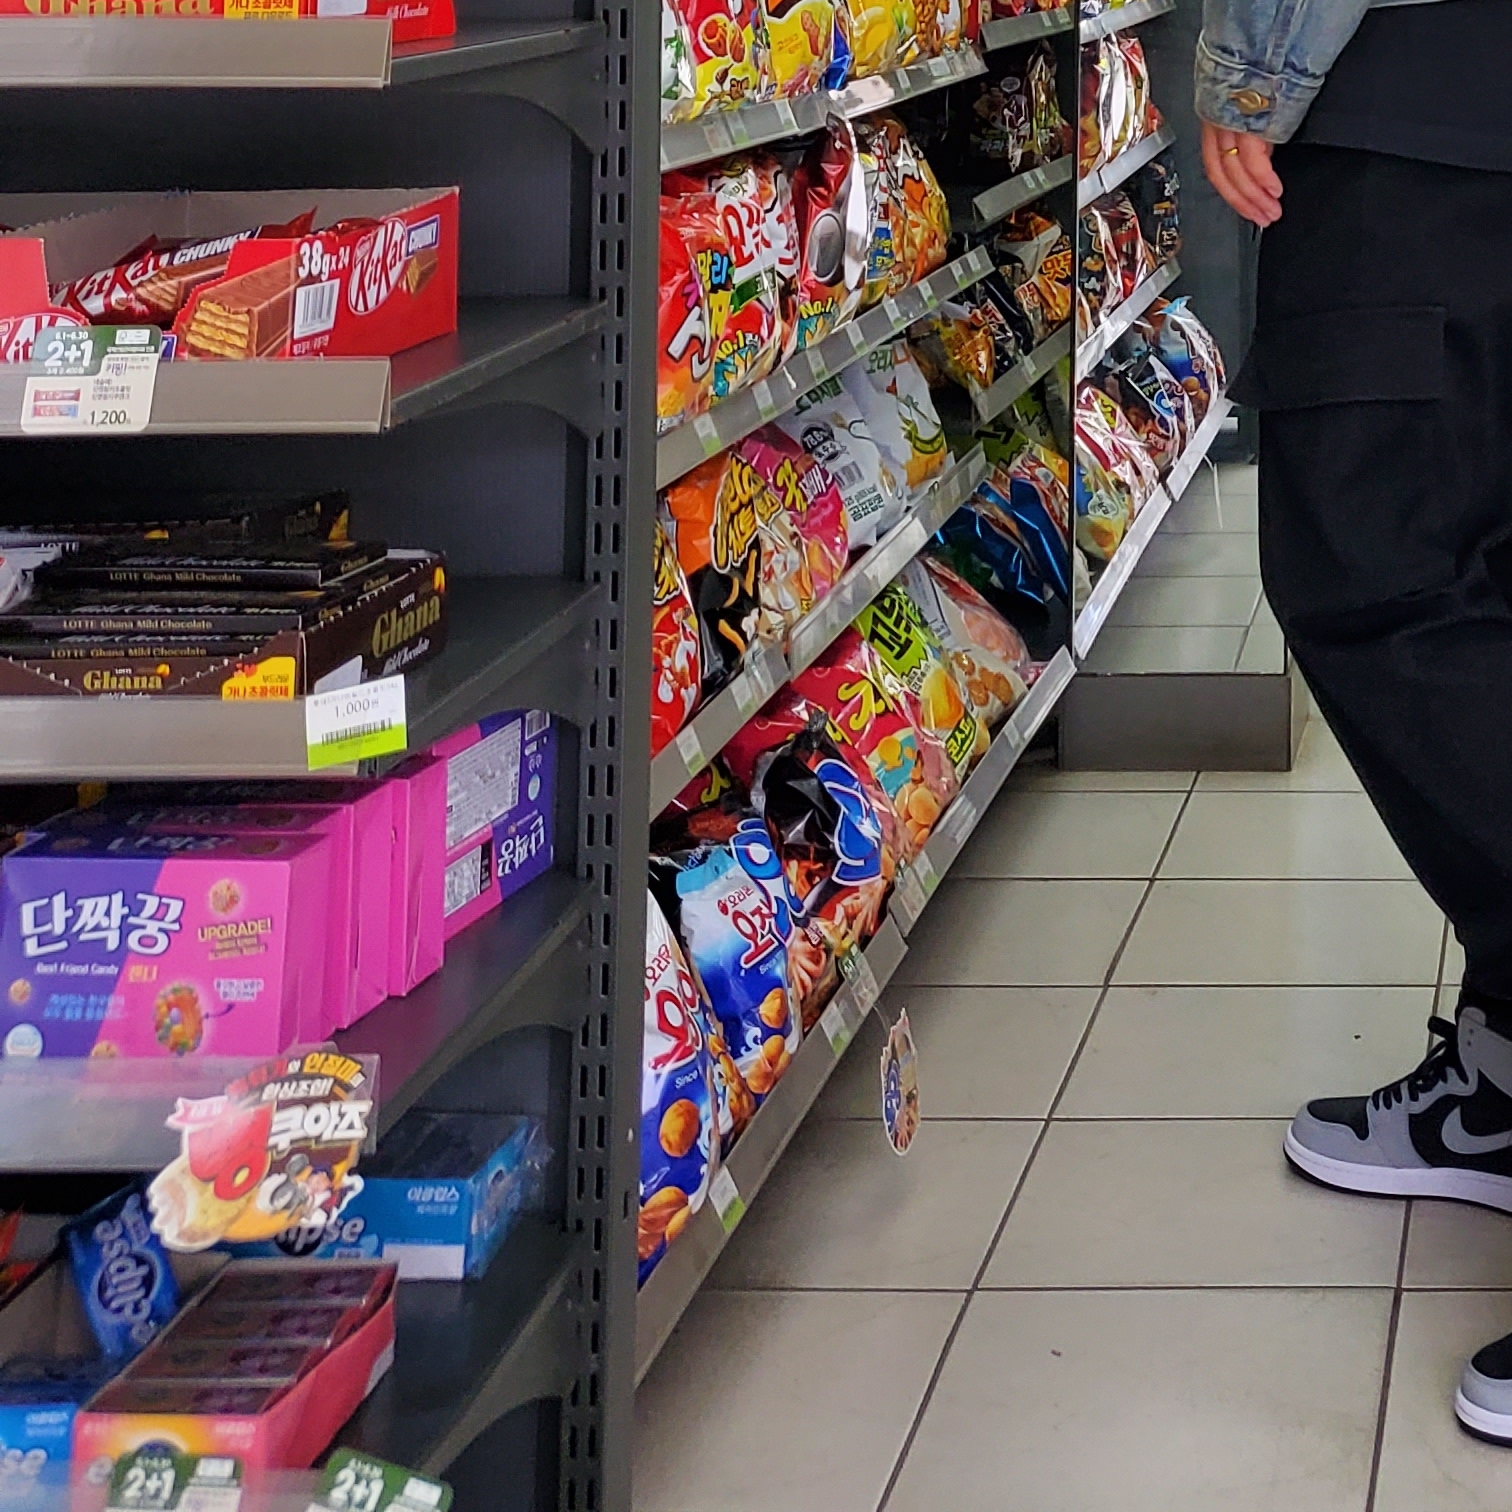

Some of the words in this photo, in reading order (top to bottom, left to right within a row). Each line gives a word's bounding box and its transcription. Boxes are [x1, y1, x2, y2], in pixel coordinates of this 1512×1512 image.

[44, 340, 94, 367] 2+1
[90, 410, 127, 425] 1,200
[372, 595, 441, 658] Ghana
[84, 672, 162, 691] Ghana
[21, 890, 184, 958] 단짝꿍
[198, 918, 272, 943] UPGRADE!
